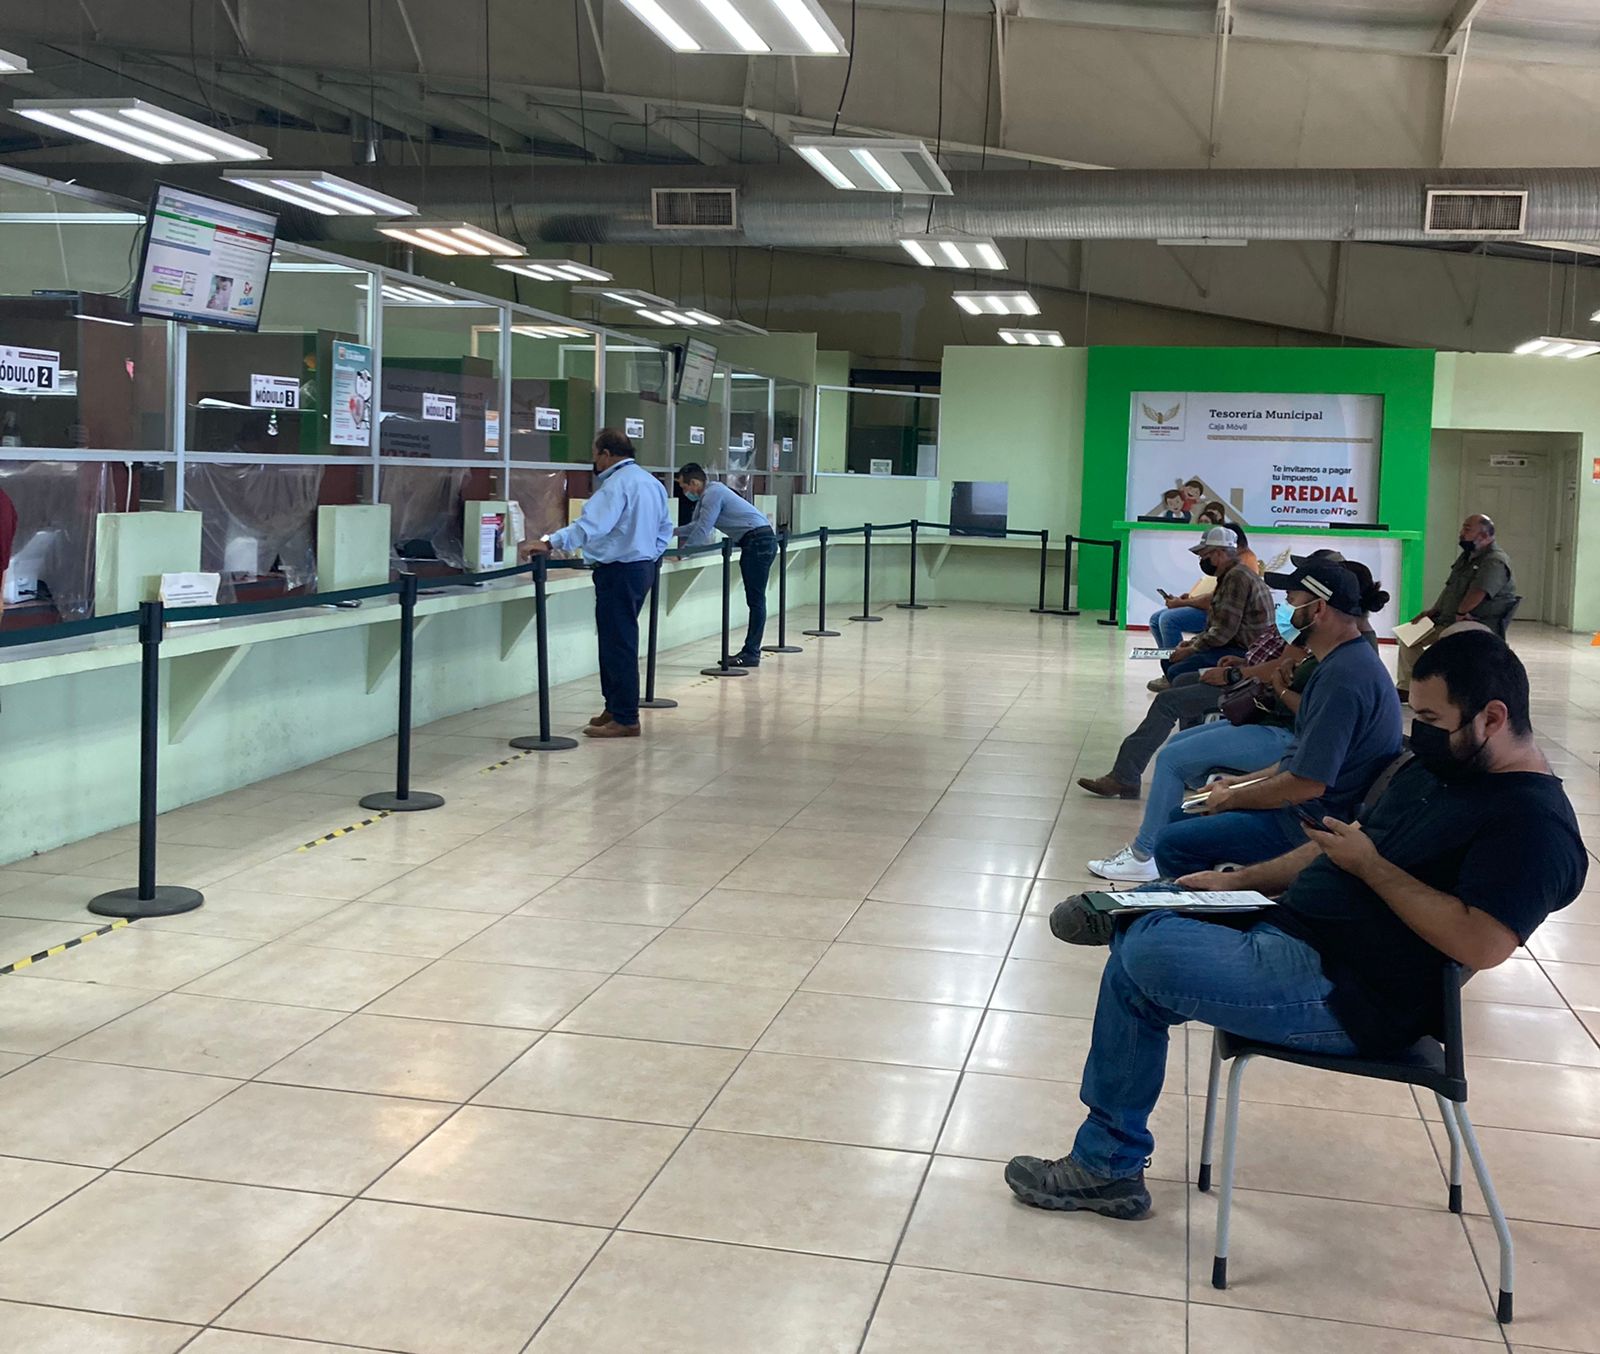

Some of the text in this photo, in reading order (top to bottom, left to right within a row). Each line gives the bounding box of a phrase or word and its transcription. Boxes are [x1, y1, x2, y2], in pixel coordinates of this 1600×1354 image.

[0, 360, 49, 385] ÓDULO 2
[255, 387, 284, 404] MÓDULO
[1209, 409, 1323, 421] Tesorería Municipal
[1208, 422, 1248, 431] Caja Móvil
[1283, 465, 1321, 473] invitamos
[1281, 474, 1318, 482] impuesto
[1271, 485, 1358, 503] PREDIAL
[1271, 505, 1358, 516] CoNTamos coNTigo
